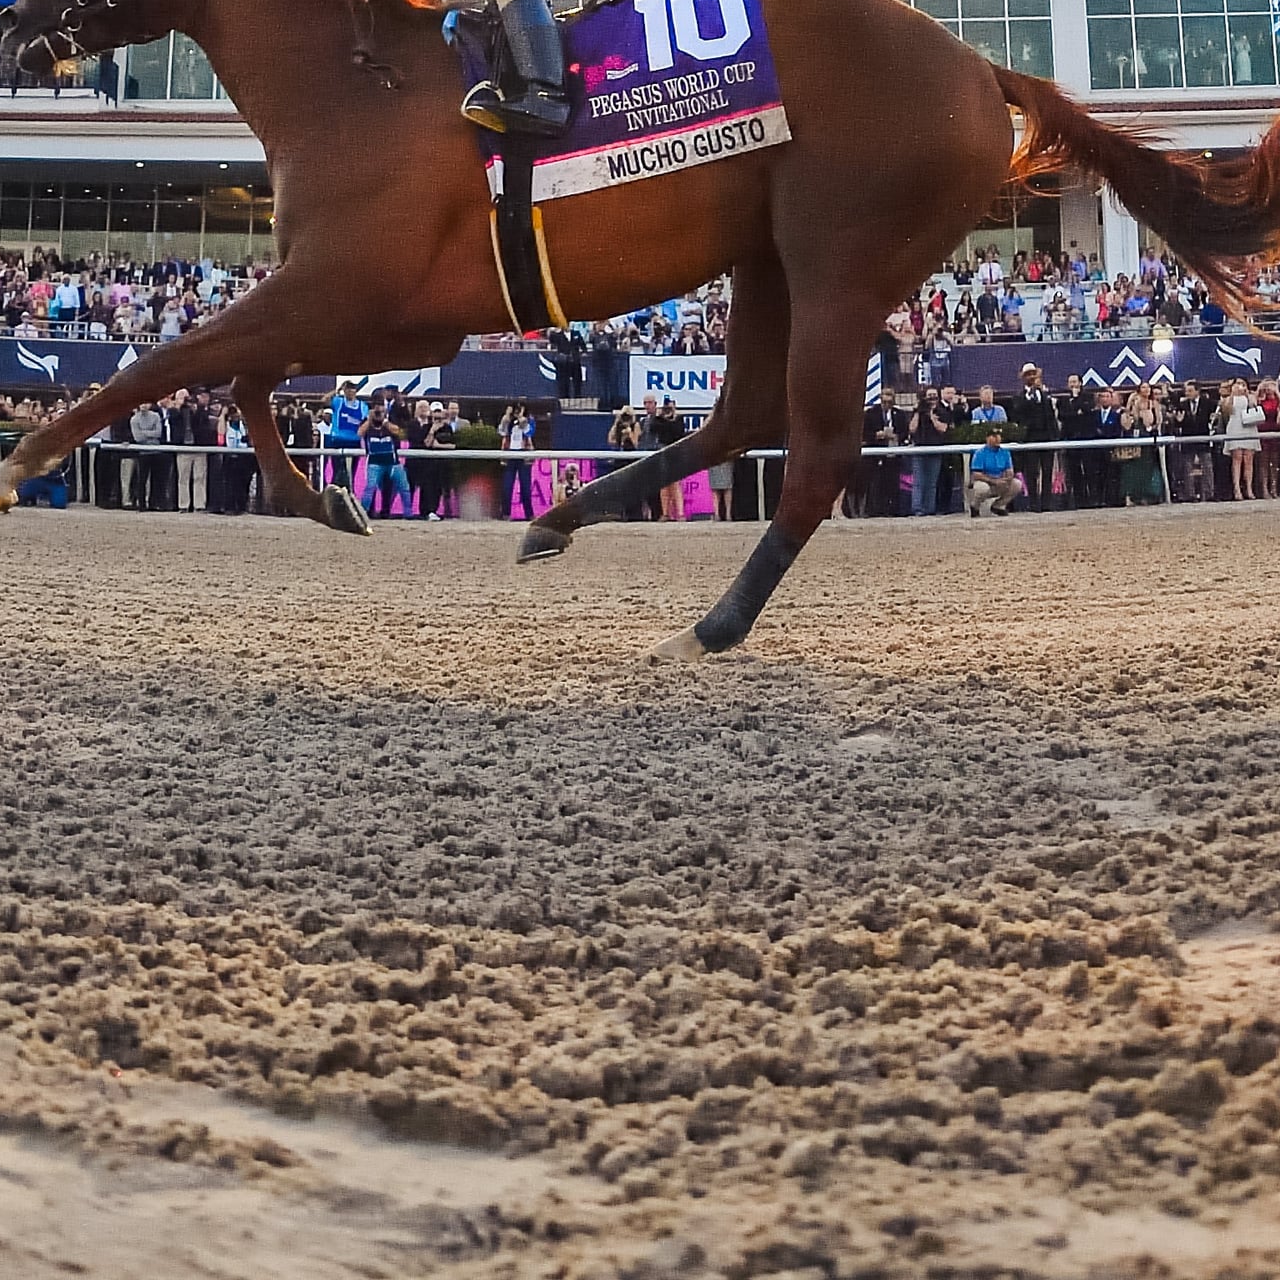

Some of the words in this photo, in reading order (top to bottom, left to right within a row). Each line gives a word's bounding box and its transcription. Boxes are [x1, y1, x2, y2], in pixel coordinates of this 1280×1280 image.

[589, 83, 663, 118] PEGASUS
[664, 70, 720, 99] WORLD
[723, 62, 756, 84] CUP
[625, 89, 729, 131] INVITATIONAL
[607, 140, 687, 179] MUCHO
[693, 118, 765, 158] GUSTO
